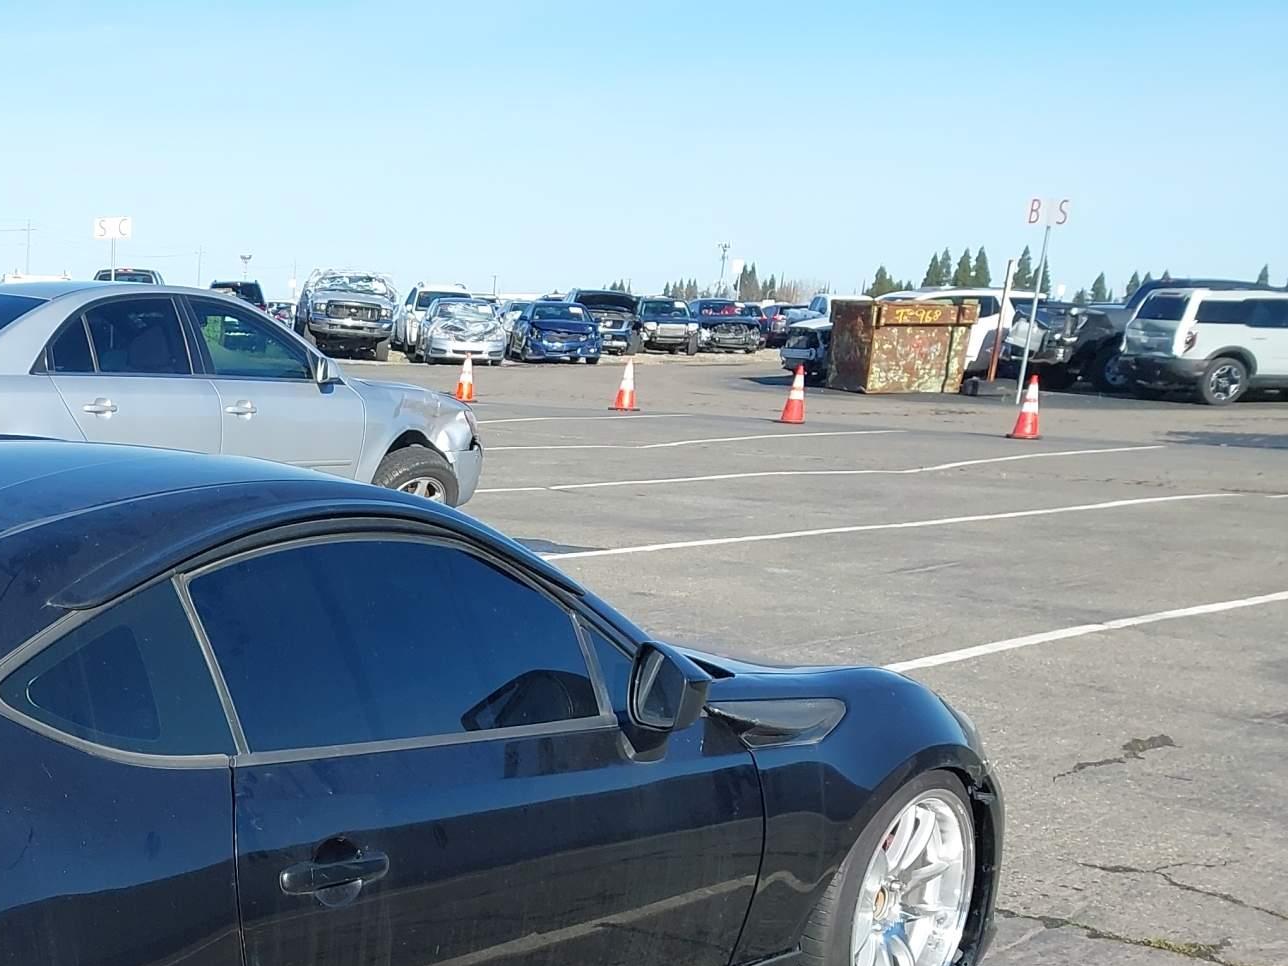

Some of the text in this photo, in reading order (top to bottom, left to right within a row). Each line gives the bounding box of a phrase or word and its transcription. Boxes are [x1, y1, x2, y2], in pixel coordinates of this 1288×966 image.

[1028, 199, 1070, 225] B S
[96, 218, 129, 236] S C
